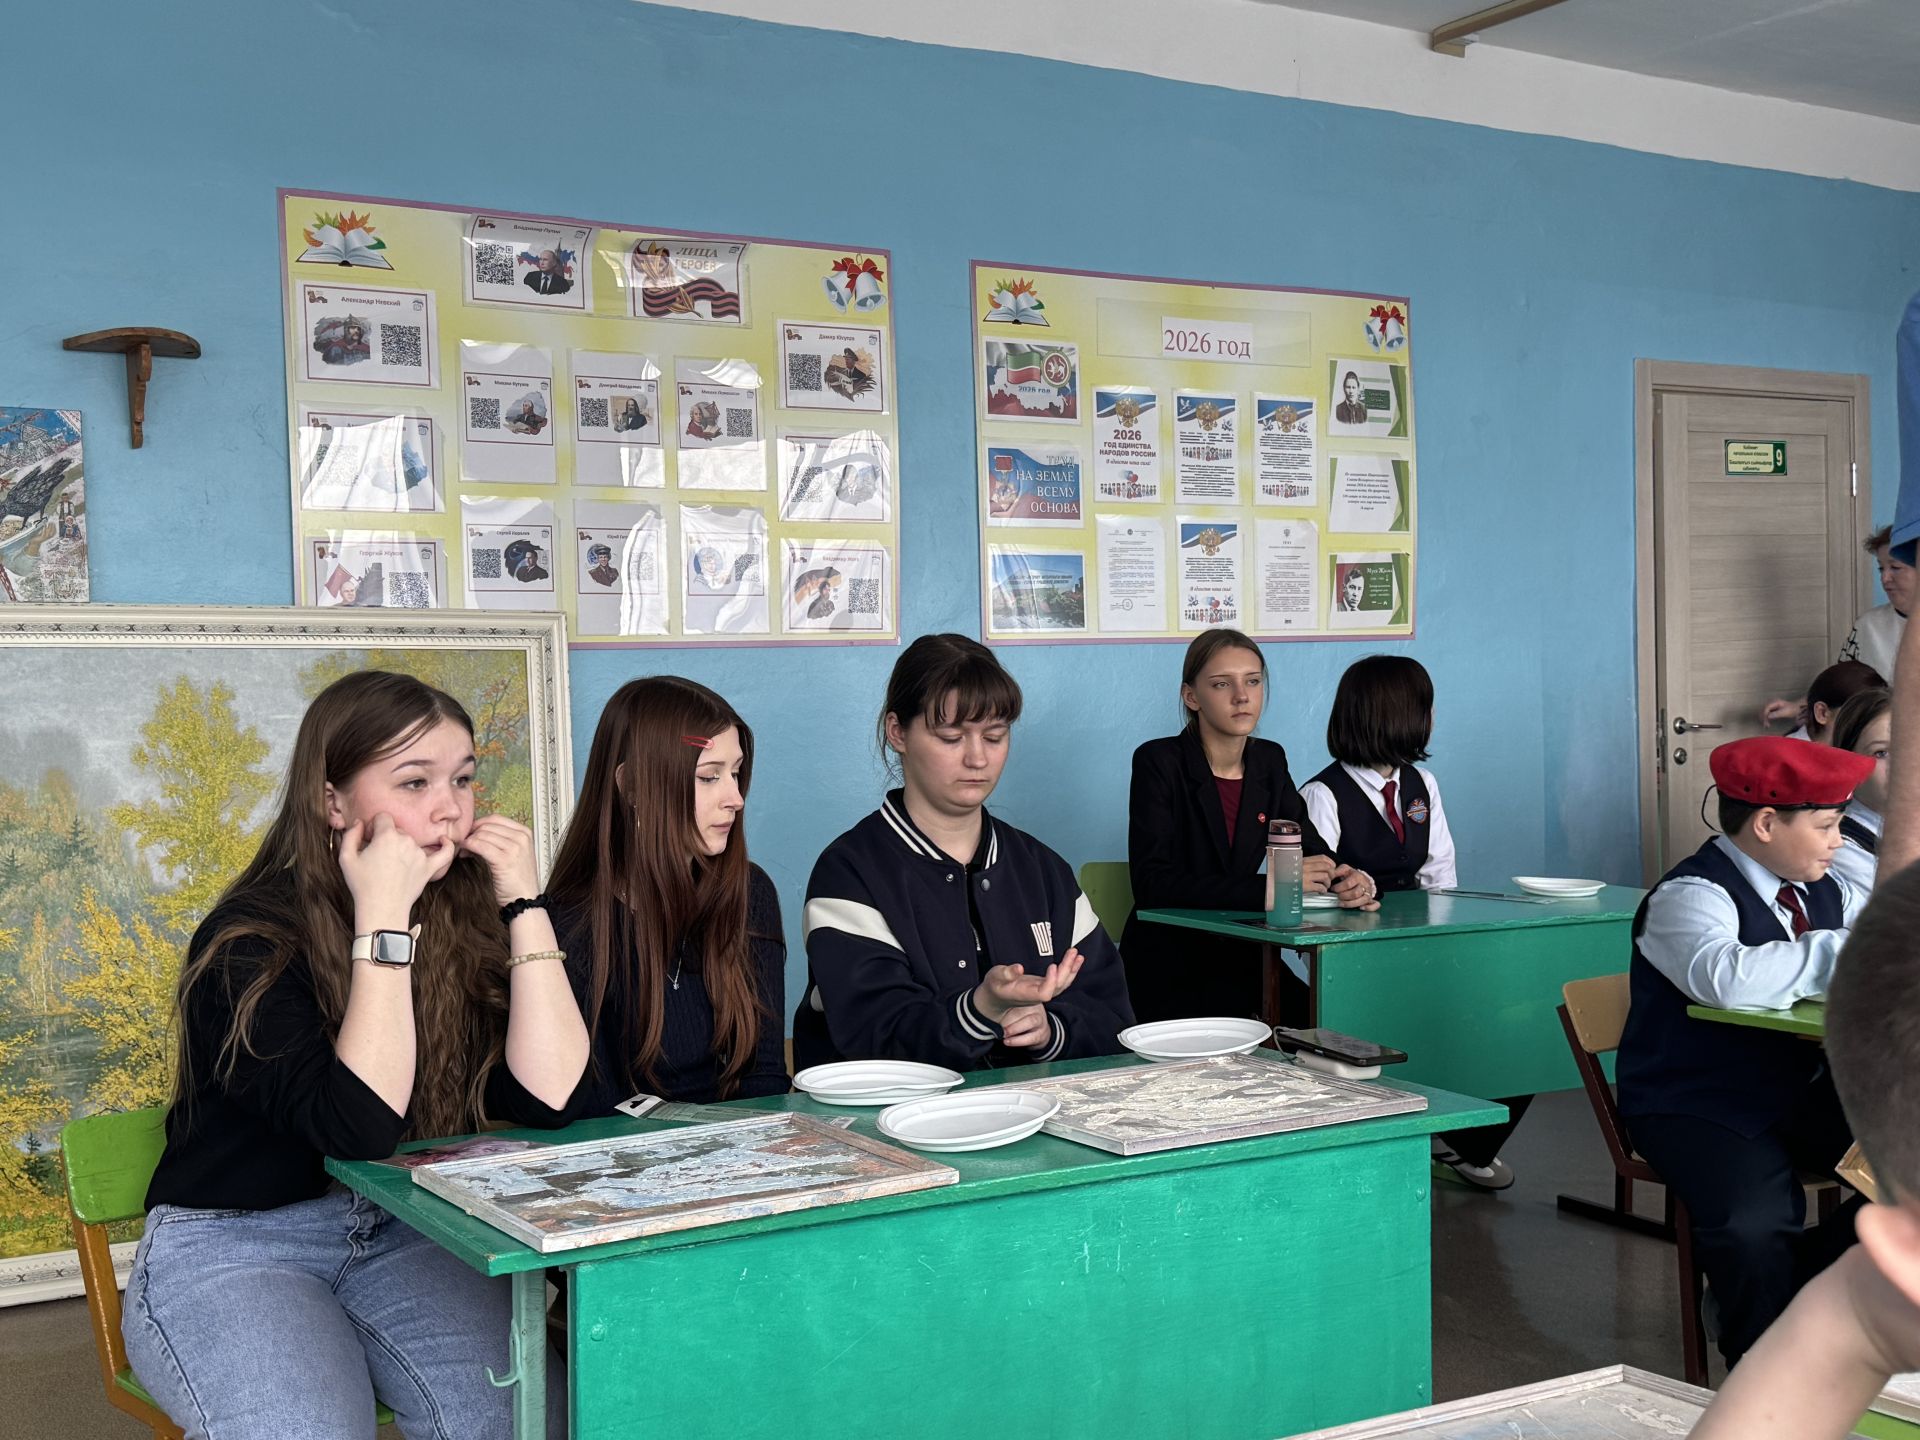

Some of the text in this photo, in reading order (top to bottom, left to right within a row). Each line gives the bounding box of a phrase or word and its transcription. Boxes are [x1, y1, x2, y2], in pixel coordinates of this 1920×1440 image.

[514, 224, 542, 232] Владимир
[676, 248, 718, 258] ЛИЦА
[341, 296, 400, 306] Александр Невский
[1164, 330, 1250, 359] 2026 год
[1018, 385, 1036, 393] 2026
[1113, 429, 1142, 441] 2026
[1118, 442, 1152, 450] ЕДИНСТВА
[1100, 448, 1130, 458] НАРОДОВ
[1776, 448, 1782, 466] 9
[1046, 455, 1075, 469] ТРУД
[1016, 470, 1075, 482] НА ЗЕМЛЕ
[1037, 486, 1076, 498] ВСЕМУ
[1030, 501, 1079, 514] ОСНОВА
